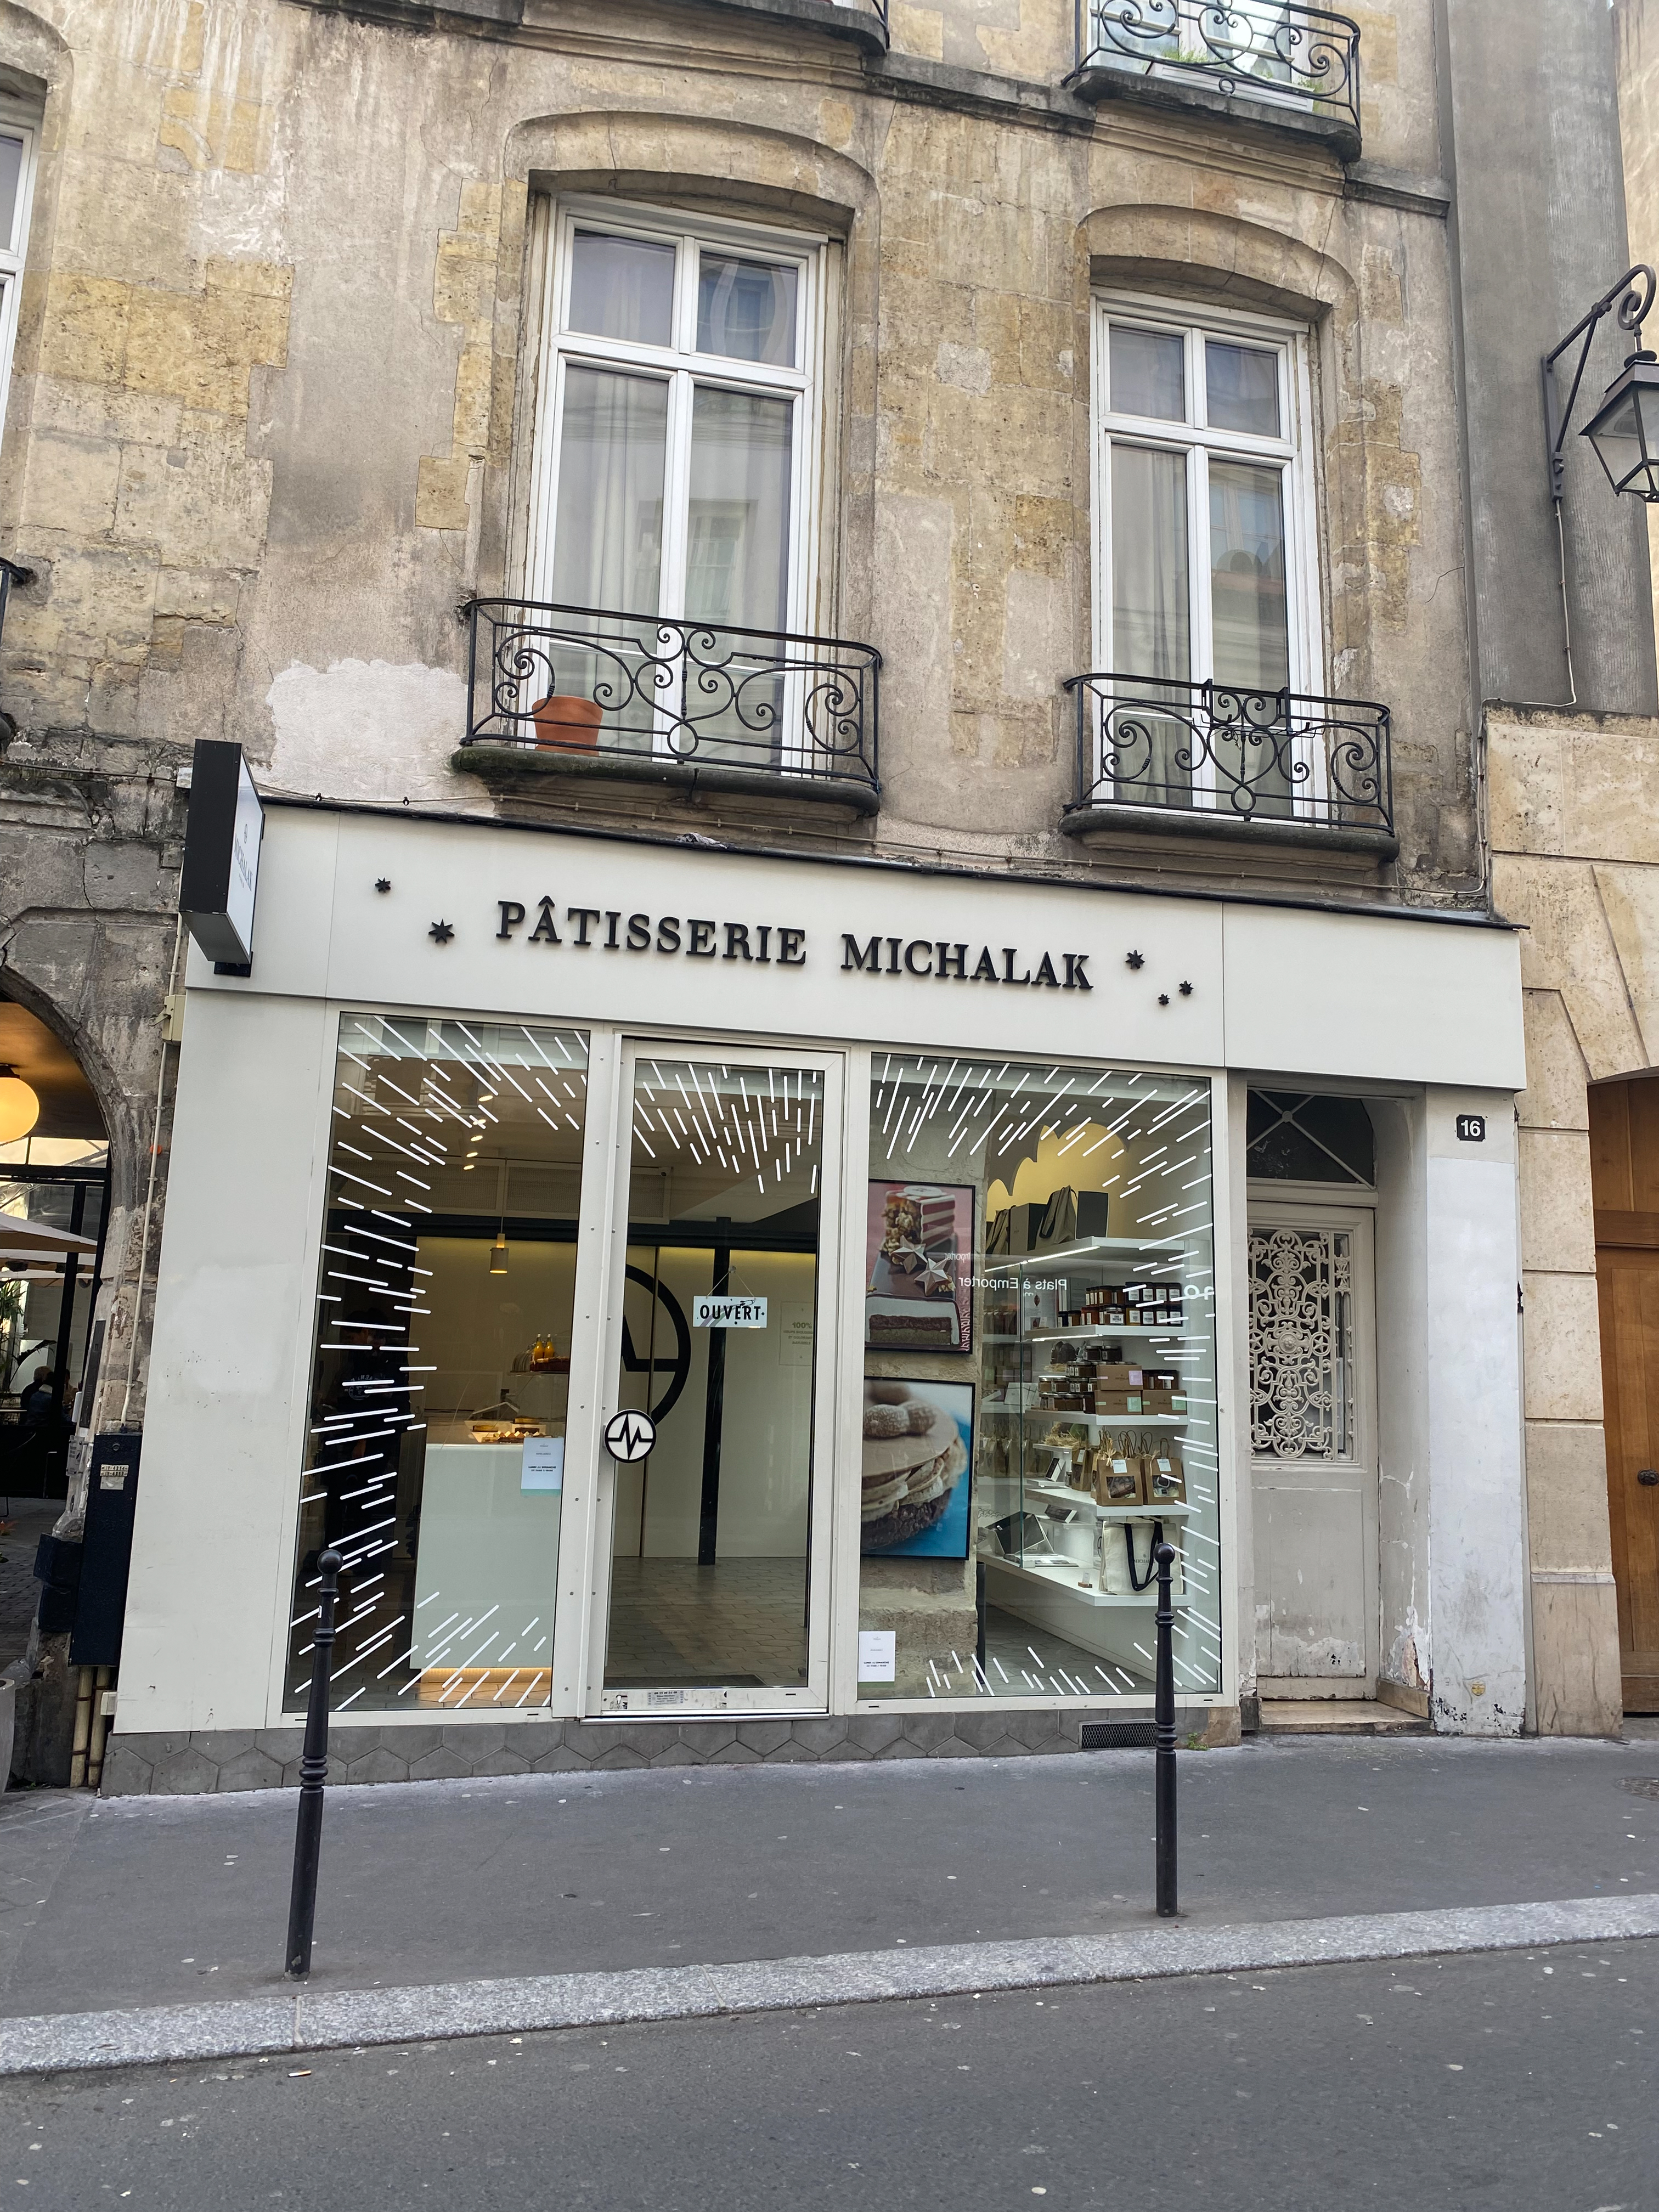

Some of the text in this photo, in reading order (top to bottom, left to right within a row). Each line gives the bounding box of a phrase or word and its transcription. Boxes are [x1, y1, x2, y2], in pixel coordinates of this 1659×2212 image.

[496, 895, 1094, 989] PÂTISSERIE MICHALAK
[1460, 1120, 1481, 1137] 16
[700, 1305, 761, 1320] OUVERT
